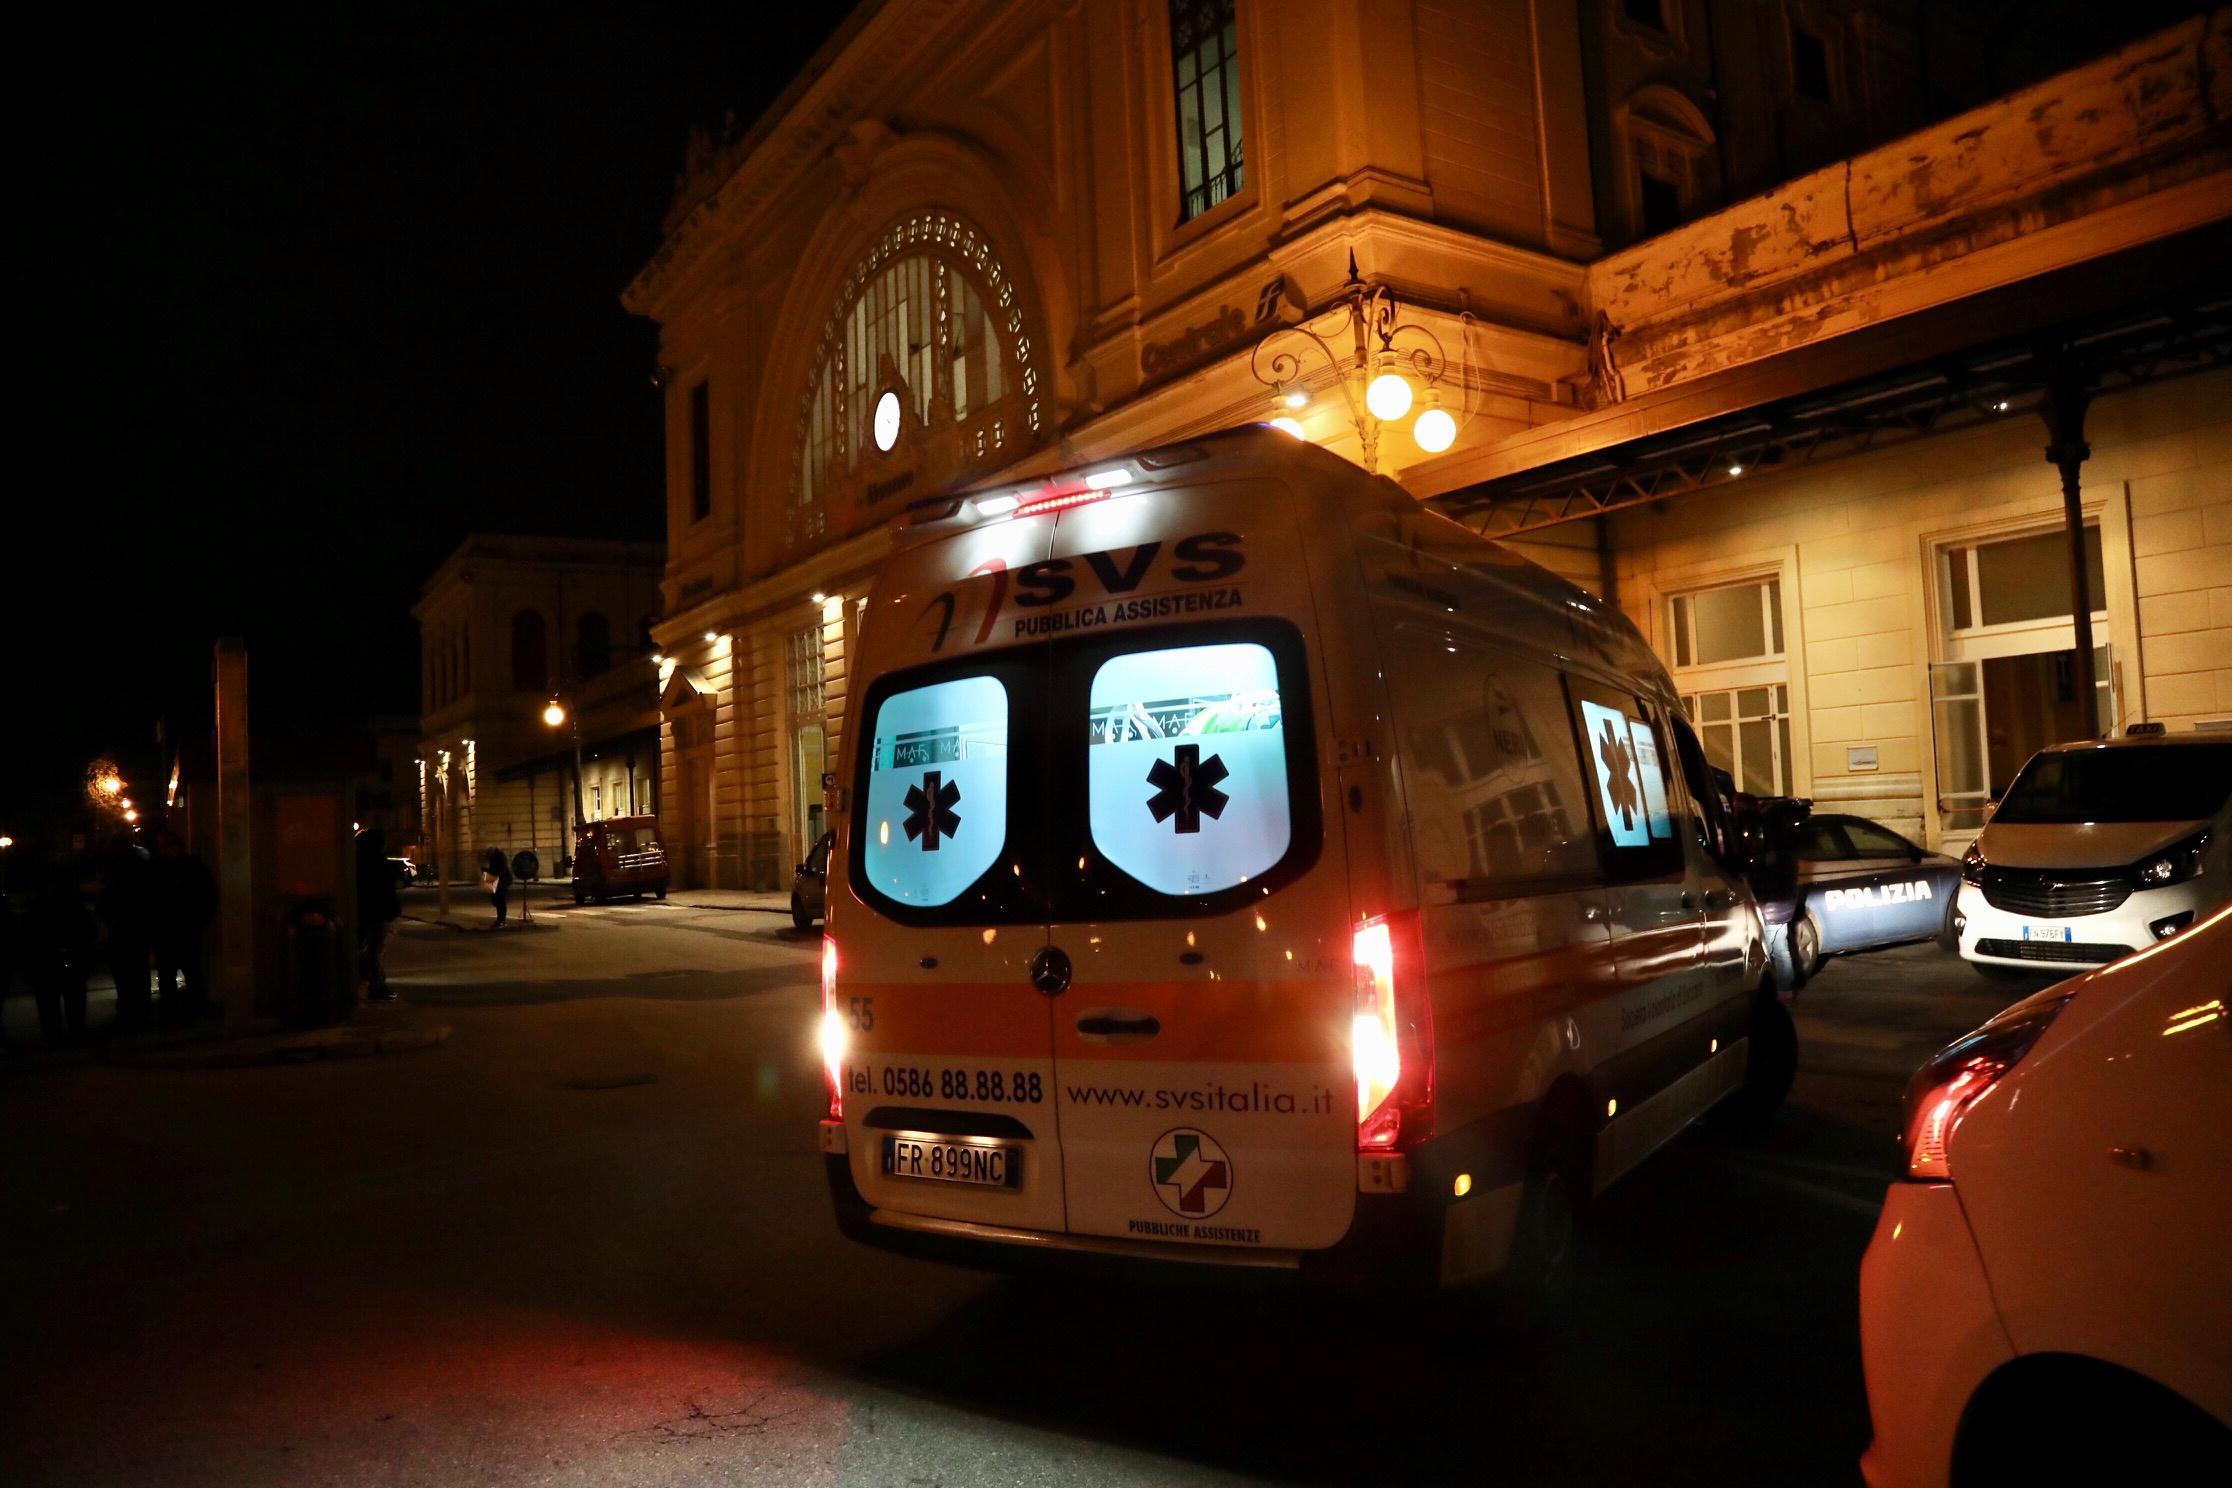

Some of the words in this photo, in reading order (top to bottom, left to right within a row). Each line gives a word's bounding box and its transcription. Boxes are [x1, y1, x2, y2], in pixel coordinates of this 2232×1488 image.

[1014, 531, 1246, 607] SVS
[1014, 606, 1108, 638] PUBBLICA
[1113, 589, 1243, 622] ASSISTENZA
[1825, 880, 1933, 911] POLIZIA
[850, 996, 875, 1032] 55
[848, 1066, 877, 1094] tel.
[884, 1066, 933, 1098] 0586
[941, 1069, 1043, 1103] 88.88.88
[1066, 1082, 1331, 1115] www.svsitalia.it
[1128, 1219, 1190, 1238] PUBBLICHE
[1193, 1225, 1261, 1243] ASSISTENZE
